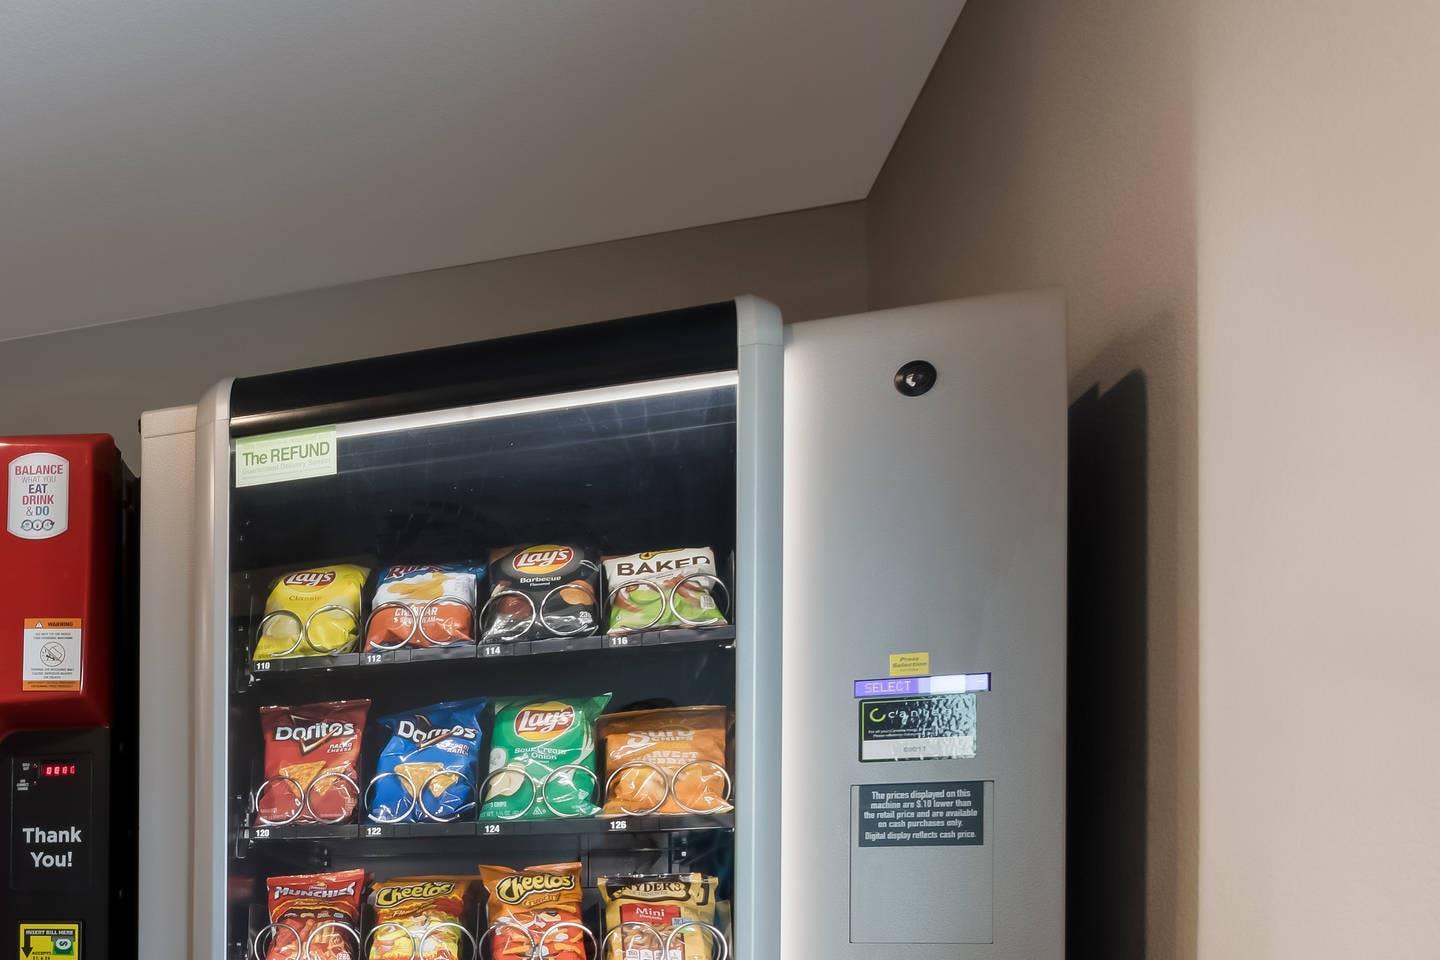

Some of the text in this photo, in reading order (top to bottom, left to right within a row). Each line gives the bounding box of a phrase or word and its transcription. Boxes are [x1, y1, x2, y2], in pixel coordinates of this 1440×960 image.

[242, 442, 330, 466] The REFUND
[15, 465, 63, 475] BALANCE
[28, 484, 48, 493] EAT
[22, 495, 54, 505] DRINK
[25, 506, 50, 516] & DO
[617, 556, 710, 576] BAKED
[520, 576, 561, 584] Barbecue
[612, 637, 628, 645] 116
[485, 647, 500, 655] 114
[367, 655, 382, 663] 112
[256, 662, 271, 670] 110
[864, 681, 912, 693] SELECT
[518, 709, 574, 732] Lay's
[275, 722, 354, 742] Doritos
[531, 752, 557, 760] Onion
[872, 791, 885, 800] The
[886, 791, 909, 801] prices
[910, 790, 944, 801] displayed
[957, 789, 971, 797] this
[871, 800, 900, 809] machine
[916, 800, 931, 808] $.10
[933, 800, 954, 808] lower
[877, 811, 895, 819] retail
[896, 811, 914, 819] price
[916, 810, 930, 818] and
[945, 809, 978, 817] available
[485, 825, 500, 833] 124
[610, 821, 627, 829] 126
[889, 820, 905, 828] cash
[907, 819, 944, 829] purchases
[22, 826, 82, 843] Thank
[255, 829, 269, 837] 120
[865, 832, 886, 841] Digital
[887, 831, 911, 841] display
[912, 831, 938, 839] reflects
[957, 831, 976, 839] price.
[30, 851, 73, 867] You!
[274, 881, 355, 899] MUNCHIES
[376, 882, 453, 906] Cheetos
[498, 875, 574, 903] Cheetos
[636, 907, 665, 917] Mini
